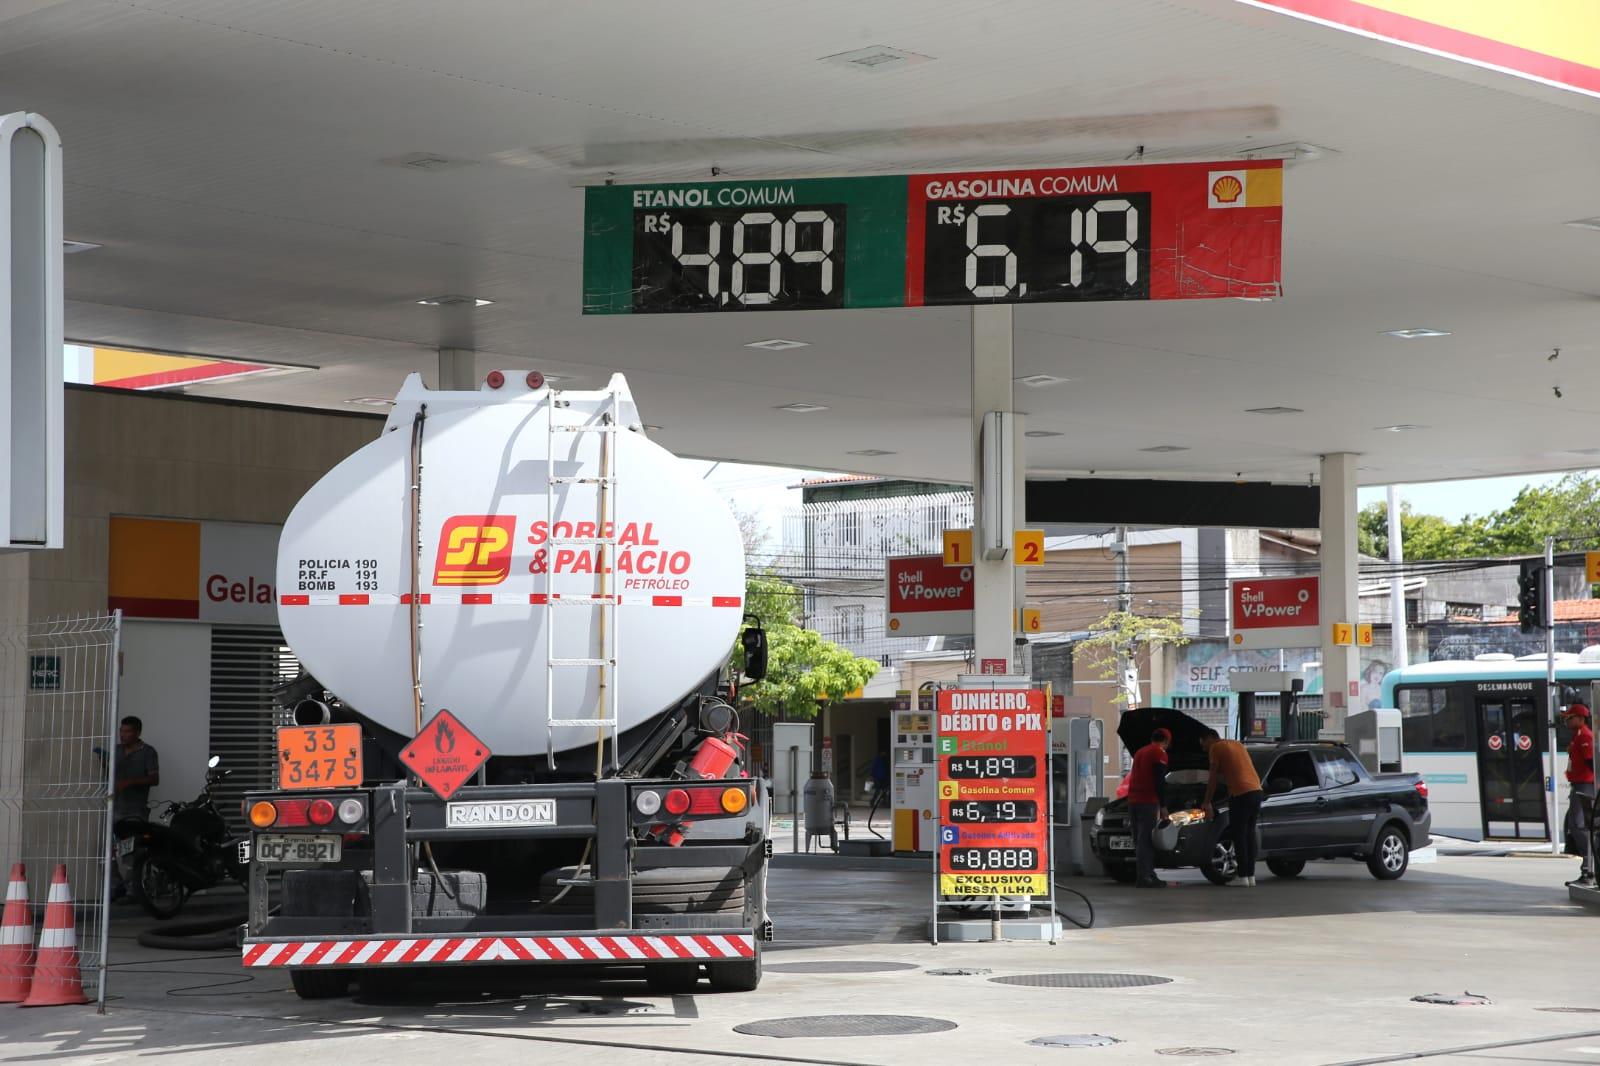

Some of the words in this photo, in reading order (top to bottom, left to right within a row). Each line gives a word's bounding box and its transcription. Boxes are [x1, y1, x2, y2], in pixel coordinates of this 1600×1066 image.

[925, 178, 1036, 199] GASOLINA
[1039, 174, 1119, 194] COMUM
[633, 189, 713, 208] ETANOL
[717, 186, 796, 206] COMUM
[937, 203, 966, 226] R$
[965, 199, 1139, 298] 6,19
[644, 212, 671, 236] R$
[671, 210, 835, 306] 4,89
[445, 526, 509, 565] SP
[951, 543, 961, 563] 1
[1023, 541, 1039, 562] 2
[298, 559, 351, 569] POLICIA
[355, 559, 378, 569] 190
[528, 548, 548, 575] &
[553, 545, 691, 575] PALÁCIO
[298, 570, 328, 580] P.R.F
[355, 570, 378, 580] 191
[898, 571, 923, 584] Shell
[206, 574, 278, 604] Gela
[298, 581, 336, 591] BOMB
[355, 581, 378, 591] 193
[624, 577, 690, 590] PETRÓLEO
[898, 584, 964, 600] V-Power
[1240, 591, 1264, 603] Shell
[1242, 603, 1302, 618] V-Power
[1031, 616, 1039, 630] 6
[1341, 630, 1347, 642] 7
[1364, 631, 1371, 643] 8
[1477, 682, 1533, 692] DESEMBARQUE
[951, 692, 1031, 711] DINHEIRO,
[941, 711, 998, 732] DÉBITO
[1001, 716, 1012, 731] e
[1015, 713, 1042, 731] PIX
[303, 730, 335, 751] 33
[942, 740, 951, 751] E
[961, 740, 1007, 751] Etanol
[289, 758, 356, 783] 3475
[951, 763, 963, 772] R$
[965, 757, 1015, 778] 4,89
[943, 785, 952, 796] G
[960, 786, 999, 794] Gasolina
[1001, 786, 1034, 794] Comum
[451, 804, 551, 822] RANDON
[952, 808, 964, 817] R$
[966, 802, 1016, 822] 6,19
[943, 829, 953, 841] G
[953, 855, 965, 863] R$
[956, 875, 1032, 884] EXCLUSIVO
[954, 886, 999, 894] NESSA
[1003, 886, 1034, 894] ILHA
